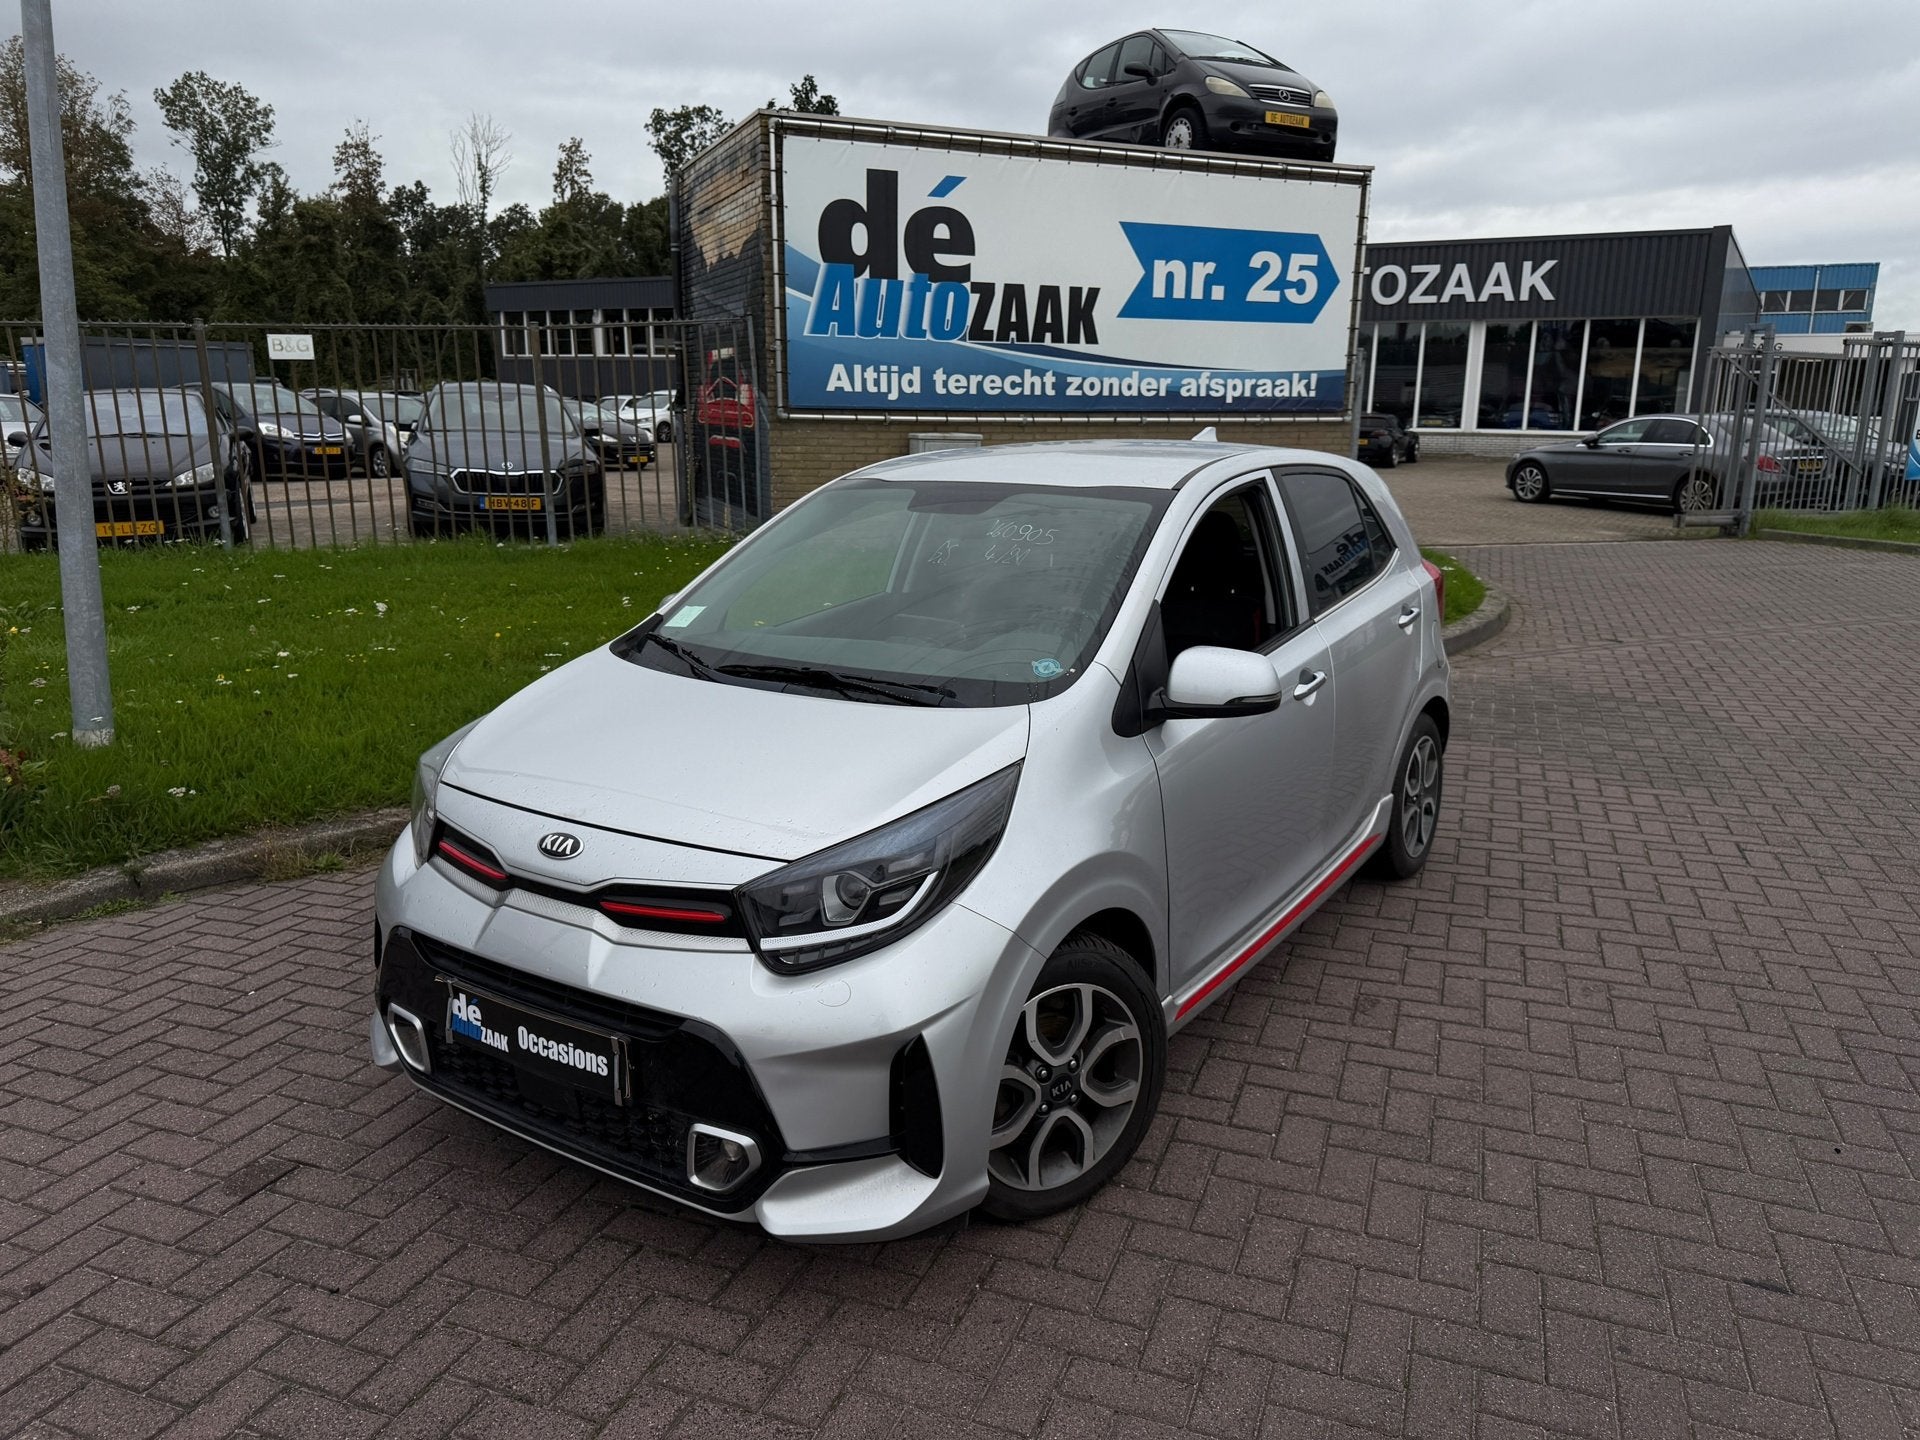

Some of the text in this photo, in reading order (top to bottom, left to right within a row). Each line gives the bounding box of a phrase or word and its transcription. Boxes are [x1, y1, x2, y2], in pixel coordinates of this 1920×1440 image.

[818, 168, 976, 283] dé
[1152, 250, 1319, 304] nr. 25
[1364, 260, 1558, 305] OZAAK
[271, 337, 310, 353] B&G
[826, 363, 1318, 404] Altijd terecht zonder afspraak!
[488, 498, 537, 509] HBV-48F
[541, 834, 574, 855] KIA
[518, 1025, 609, 1077] Occasions
[1052, 1080, 1072, 1097] KIA
